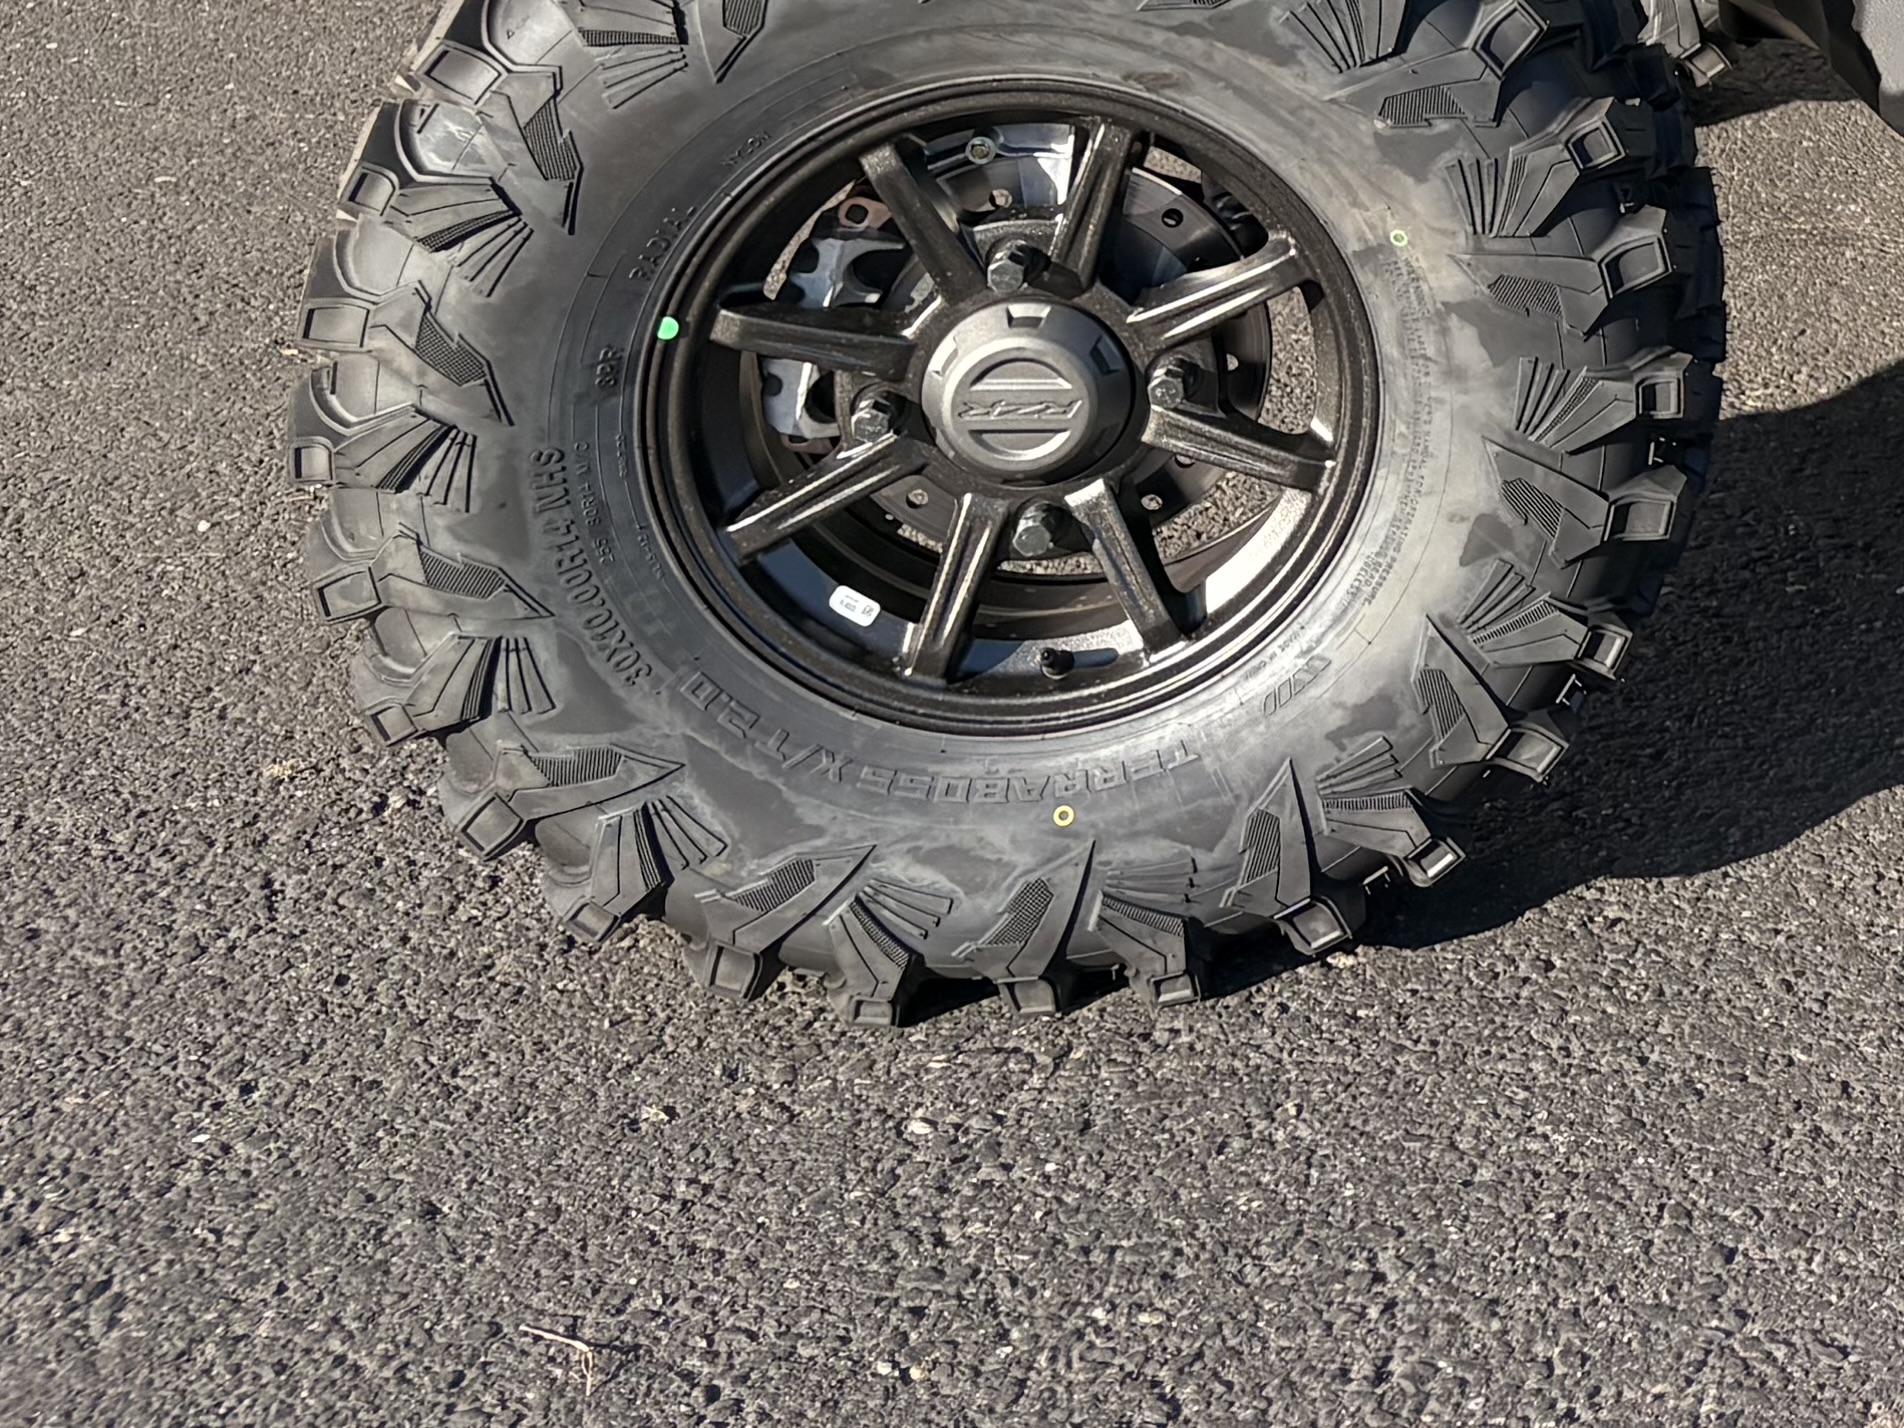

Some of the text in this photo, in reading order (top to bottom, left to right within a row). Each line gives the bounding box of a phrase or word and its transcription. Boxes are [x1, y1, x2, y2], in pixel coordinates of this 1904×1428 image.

[628, 205, 697, 283] RADIAL
[530, 446, 572, 515] NHS
[542, 516, 653, 688] 30X10.00R14
